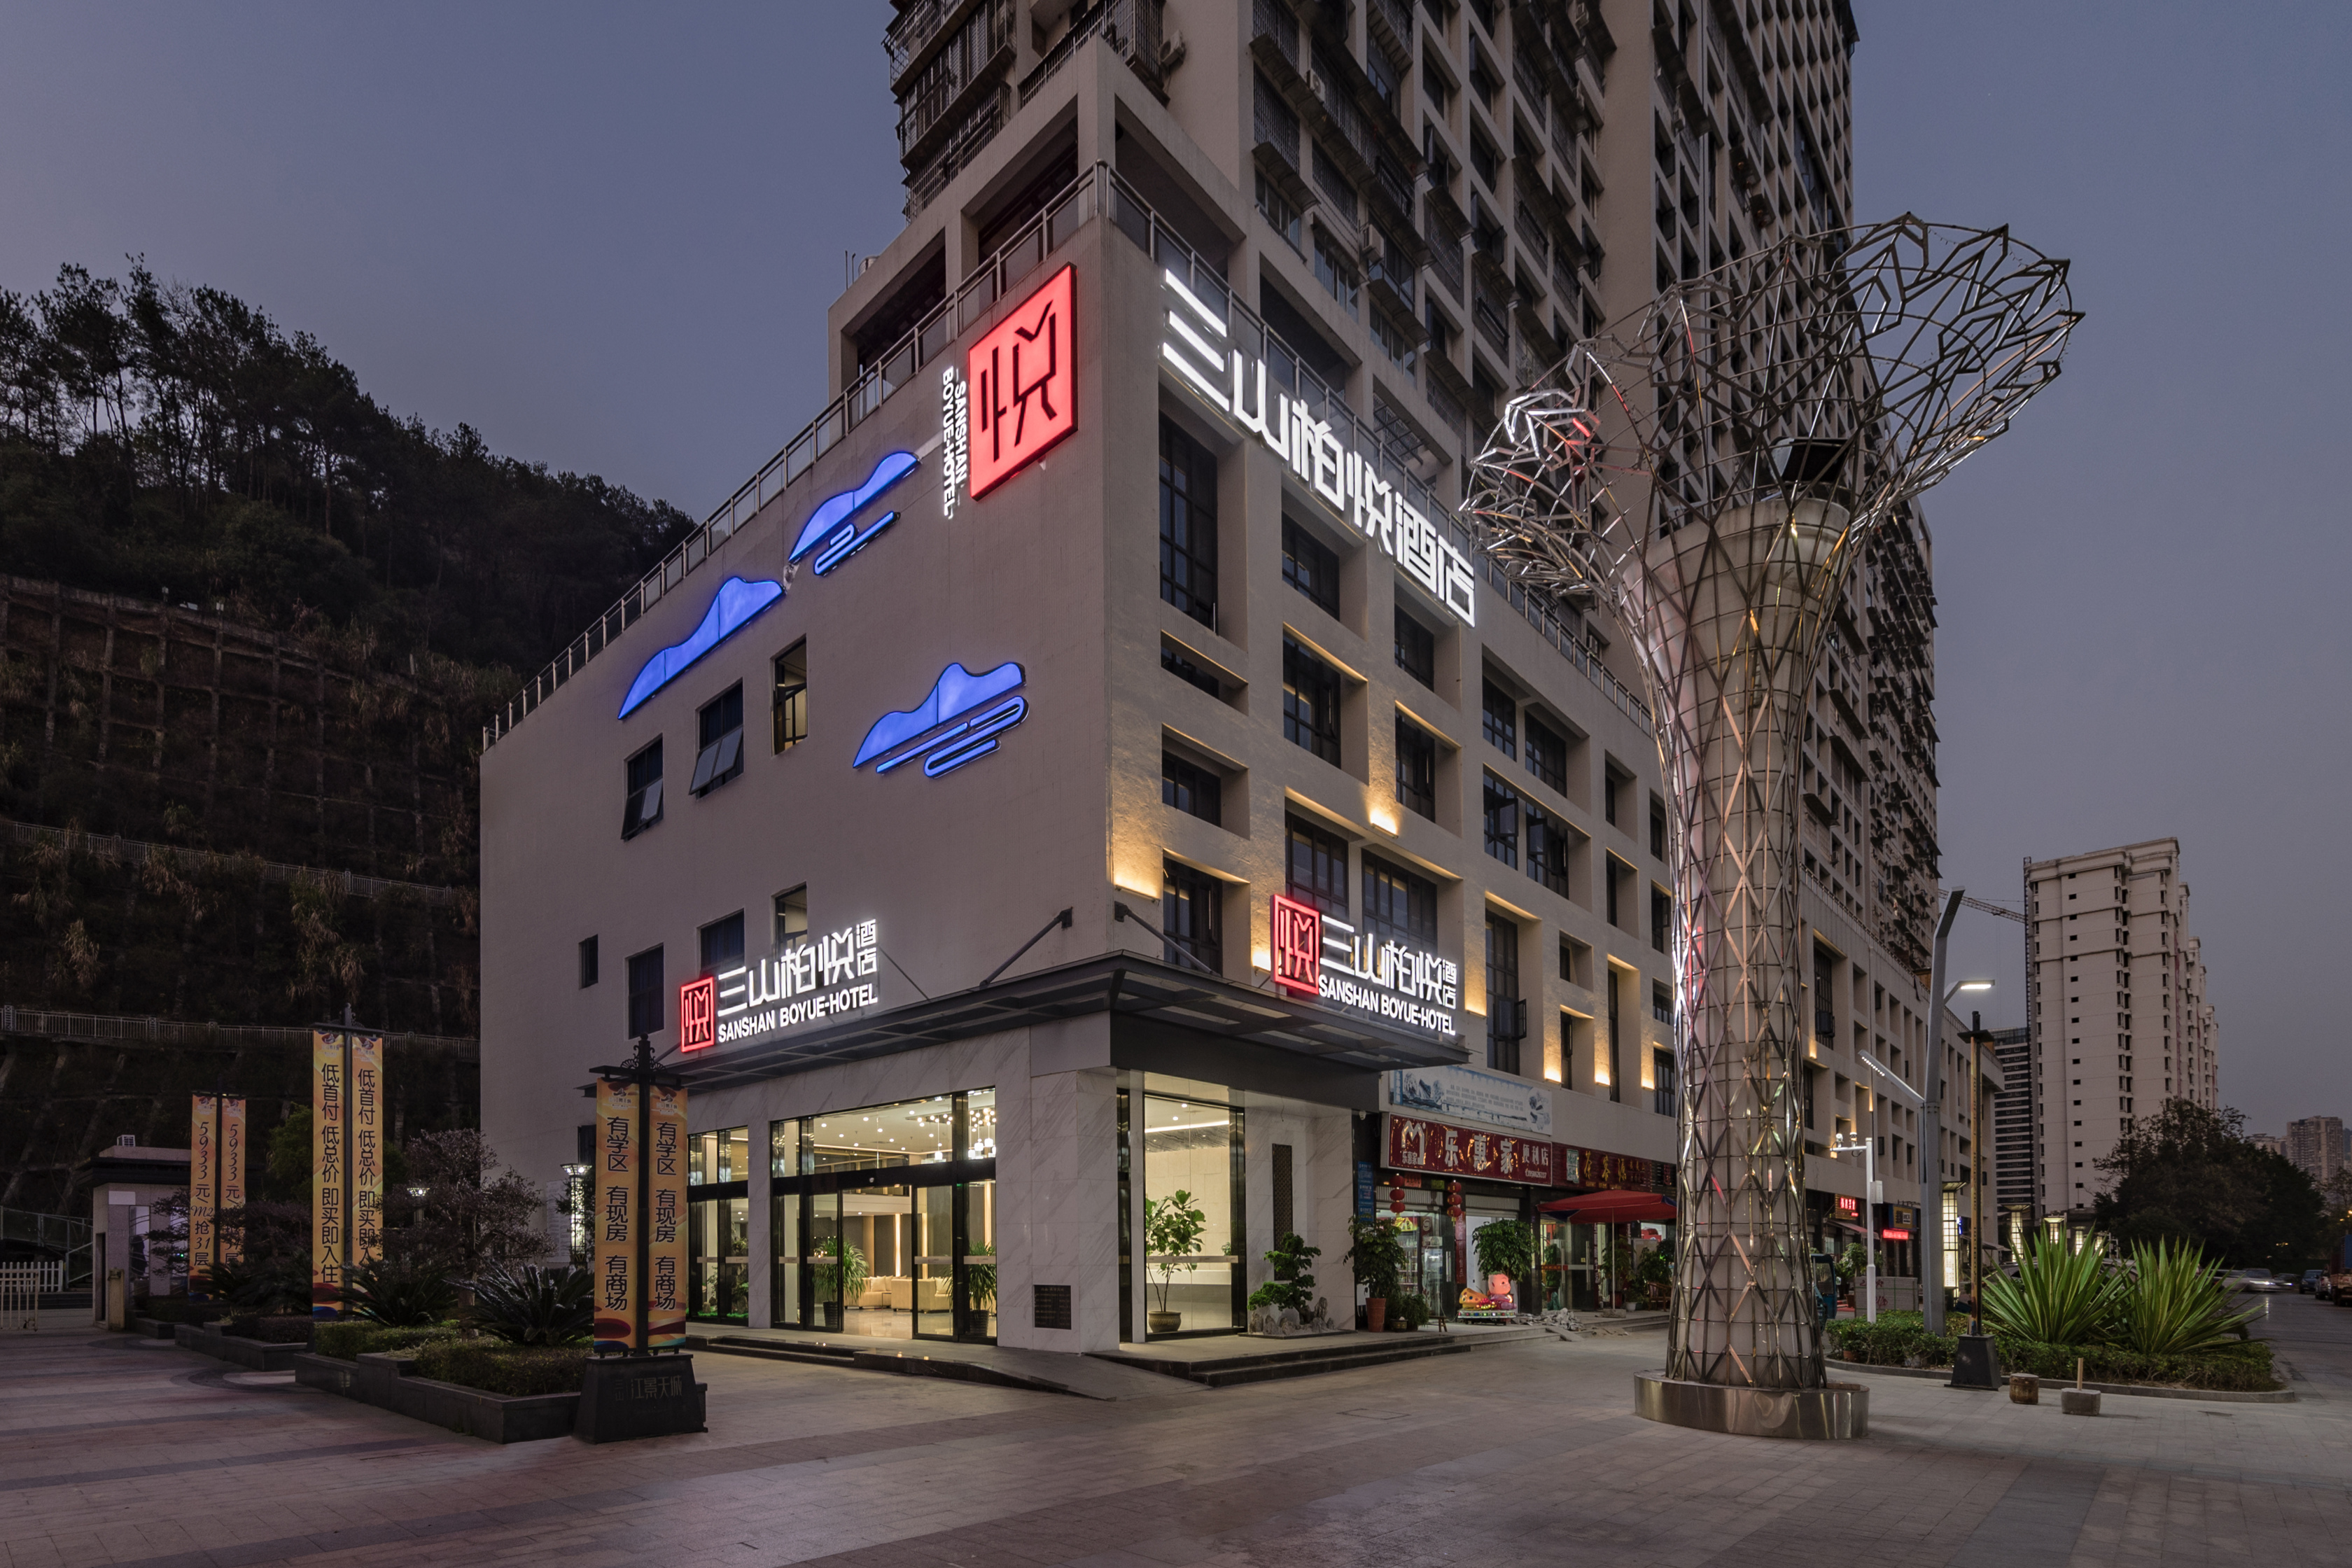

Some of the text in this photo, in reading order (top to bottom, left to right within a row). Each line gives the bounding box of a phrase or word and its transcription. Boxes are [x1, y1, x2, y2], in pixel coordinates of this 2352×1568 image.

[980, 301, 1058, 462] 悦
[943, 366, 955, 517] BOYUE-HOTEL
[955, 381, 967, 484] SANSHAN
[1161, 269, 1476, 627] 三山柏悦酒店
[718, 927, 855, 1017] 三山柏悦
[856, 918, 877, 976] 酒店
[1280, 909, 1314, 983] 悦
[1320, 914, 1443, 1005] 三山柏悦
[718, 983, 878, 1043] SANSHAN BOYUE-HOTEL
[1319, 974, 1456, 1036] SANSHAN BOYUE-HOTEL
[1442, 959, 1457, 1009] 酒店
[685, 986, 709, 1043] 悦
[321, 1063, 340, 1121] 低首付
[358, 1068, 375, 1126] 低首付
[321, 1125, 340, 1184] 低总价
[358, 1129, 375, 1186] 低总价
[606, 1116, 629, 1172] 有学区
[654, 1121, 678, 1176] 有学区
[1401, 1150, 1418, 1165] 乐惠家
[1444, 1130, 1514, 1174] 乐惠家
[1522, 1143, 1549, 1166] 便利店
[321, 1188, 340, 1284] 即买即入住
[606, 1185, 629, 1243] 有现房
[654, 1188, 677, 1244] 有现房
[605, 1254, 628, 1312] 有商场
[654, 1255, 677, 1311] 有商场
[631, 1374, 682, 1401] 江景天城
